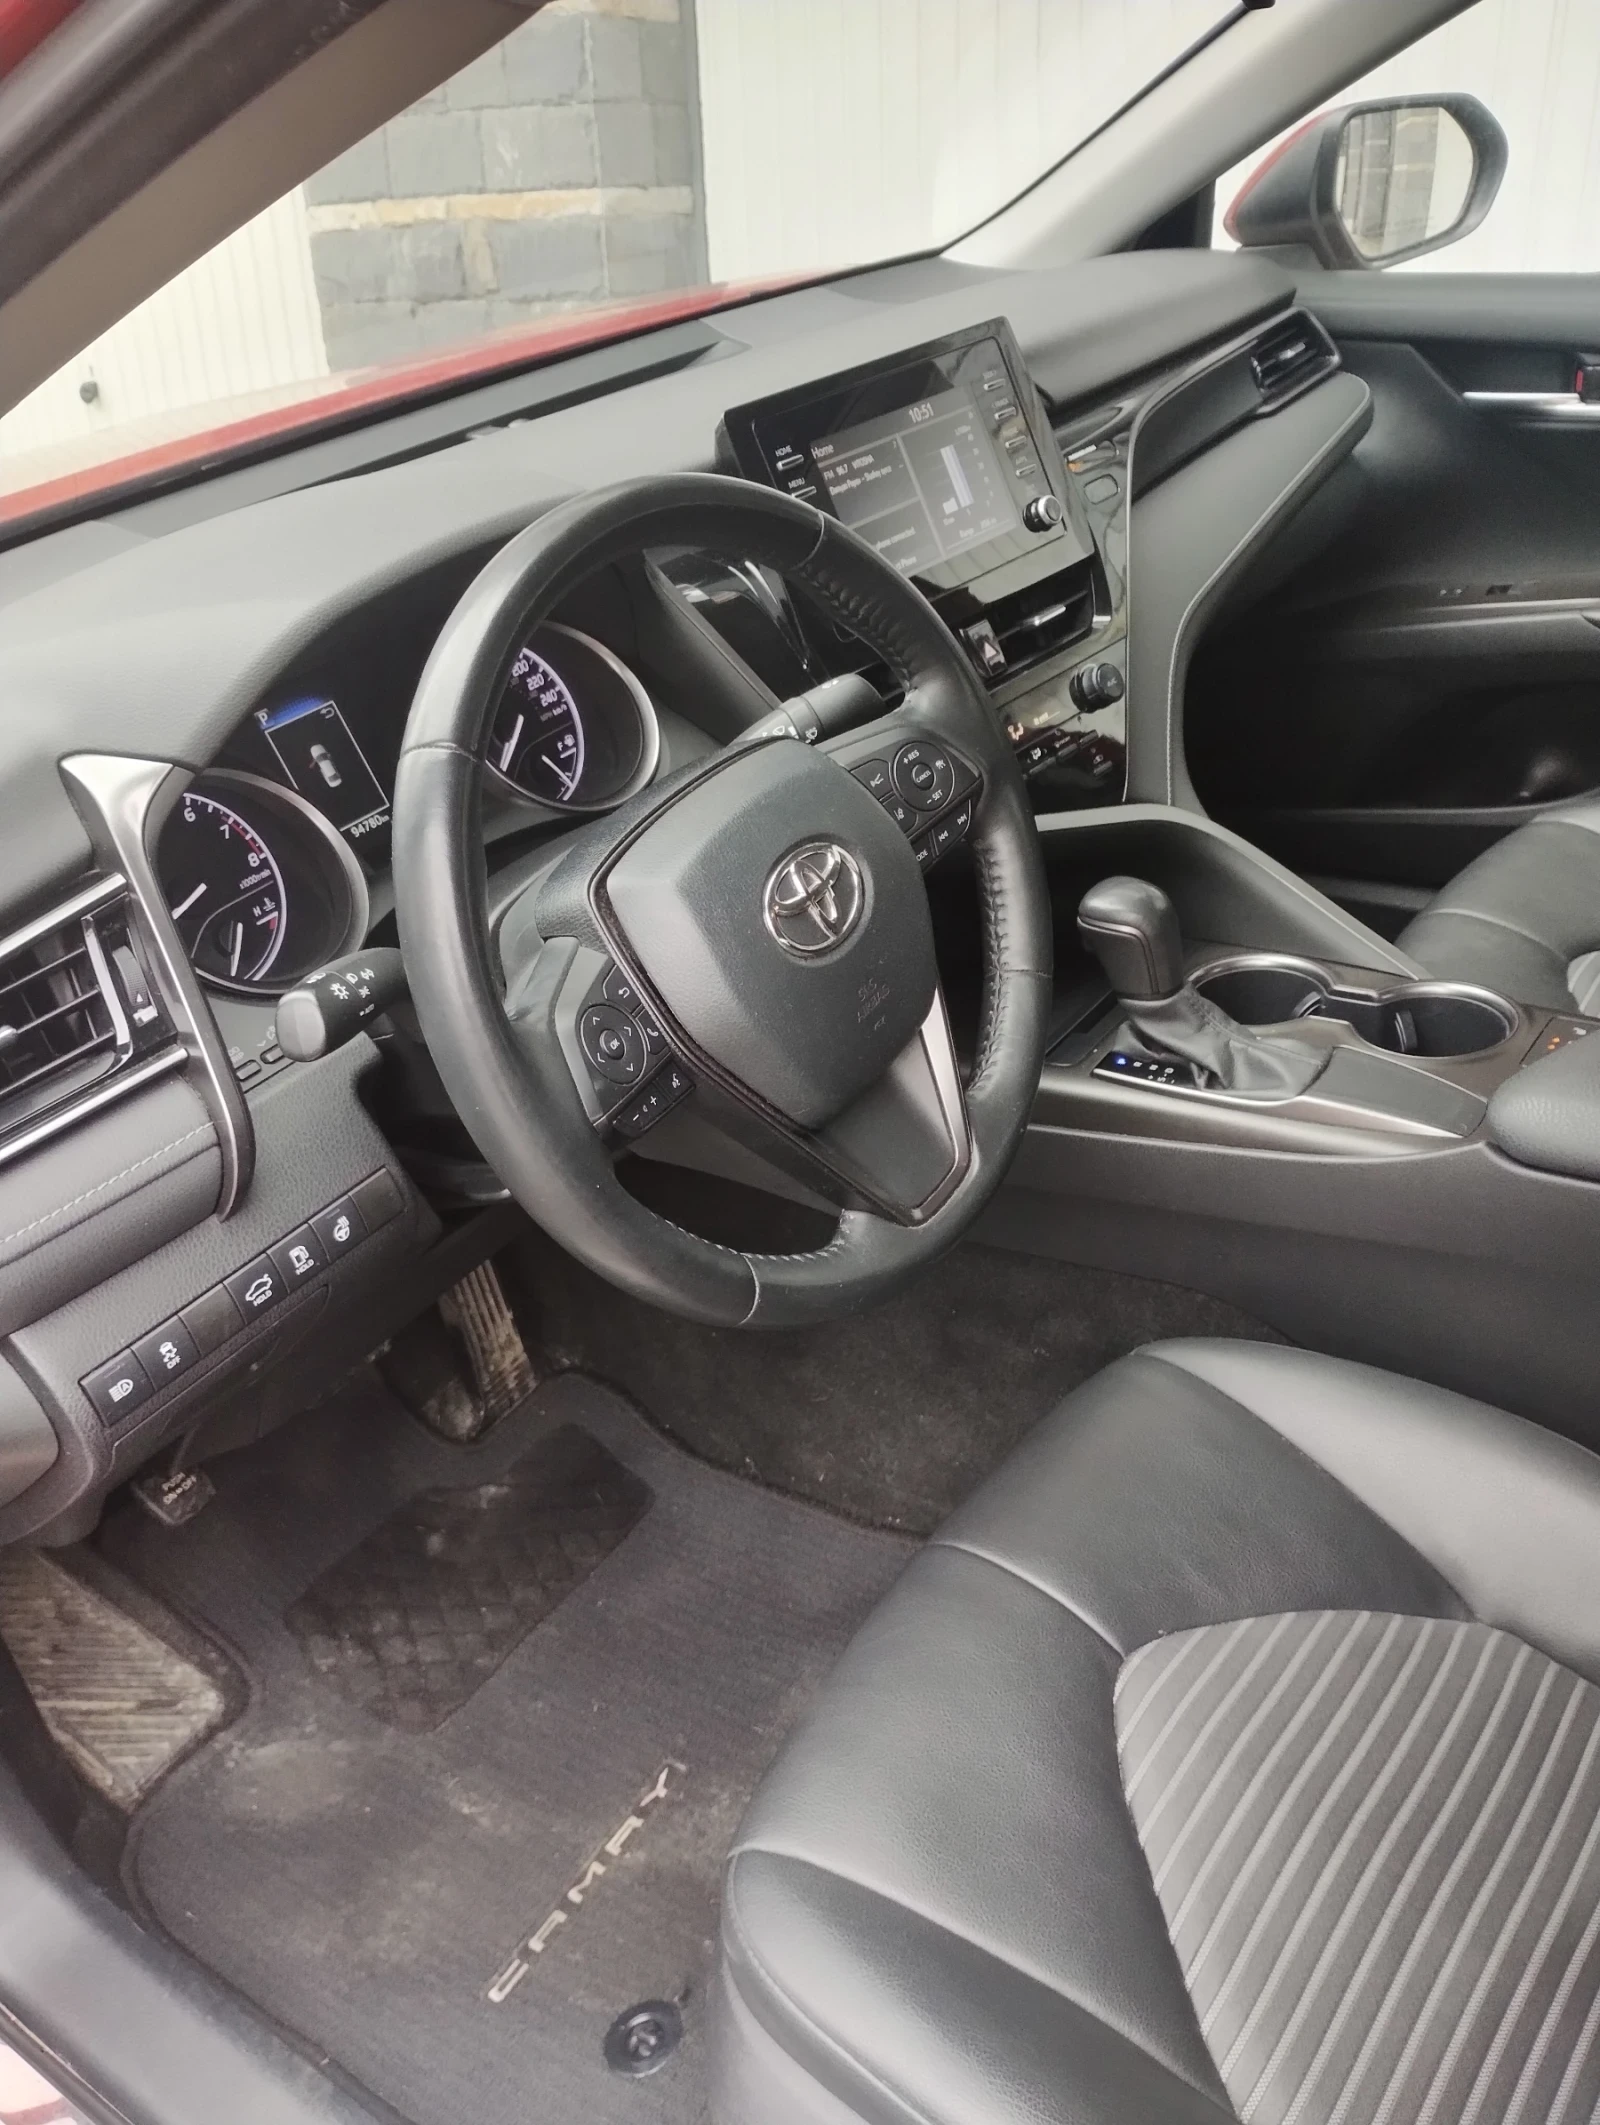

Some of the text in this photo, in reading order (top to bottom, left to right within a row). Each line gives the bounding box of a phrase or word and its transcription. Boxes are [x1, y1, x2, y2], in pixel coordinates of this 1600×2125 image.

[908, 402, 935, 424] 10:51
[775, 445, 792, 457] HOME
[811, 443, 834, 460] Home
[823, 470, 835, 481] FM
[788, 477, 805, 489] MENU
[526, 673, 544, 691] 220
[540, 689, 558, 707] 240
[258, 712, 268, 726] P
[908, 750, 919, 761] RES
[932, 789, 943, 801] SET
[184, 807, 196, 822] 6
[220, 825, 230, 839] 7
[351, 814, 382, 838] 94780
[248, 852, 260, 867] 8
[915, 849, 929, 862] ODE
[253, 905, 262, 917] H
[610, 1038, 620, 1050] OK
[295, 1258, 315, 1275] HOLD
[253, 1290, 272, 1307] HOLD
[166, 1355, 181, 1369] OFF
[488, 1766, 669, 2003] CAMRY
